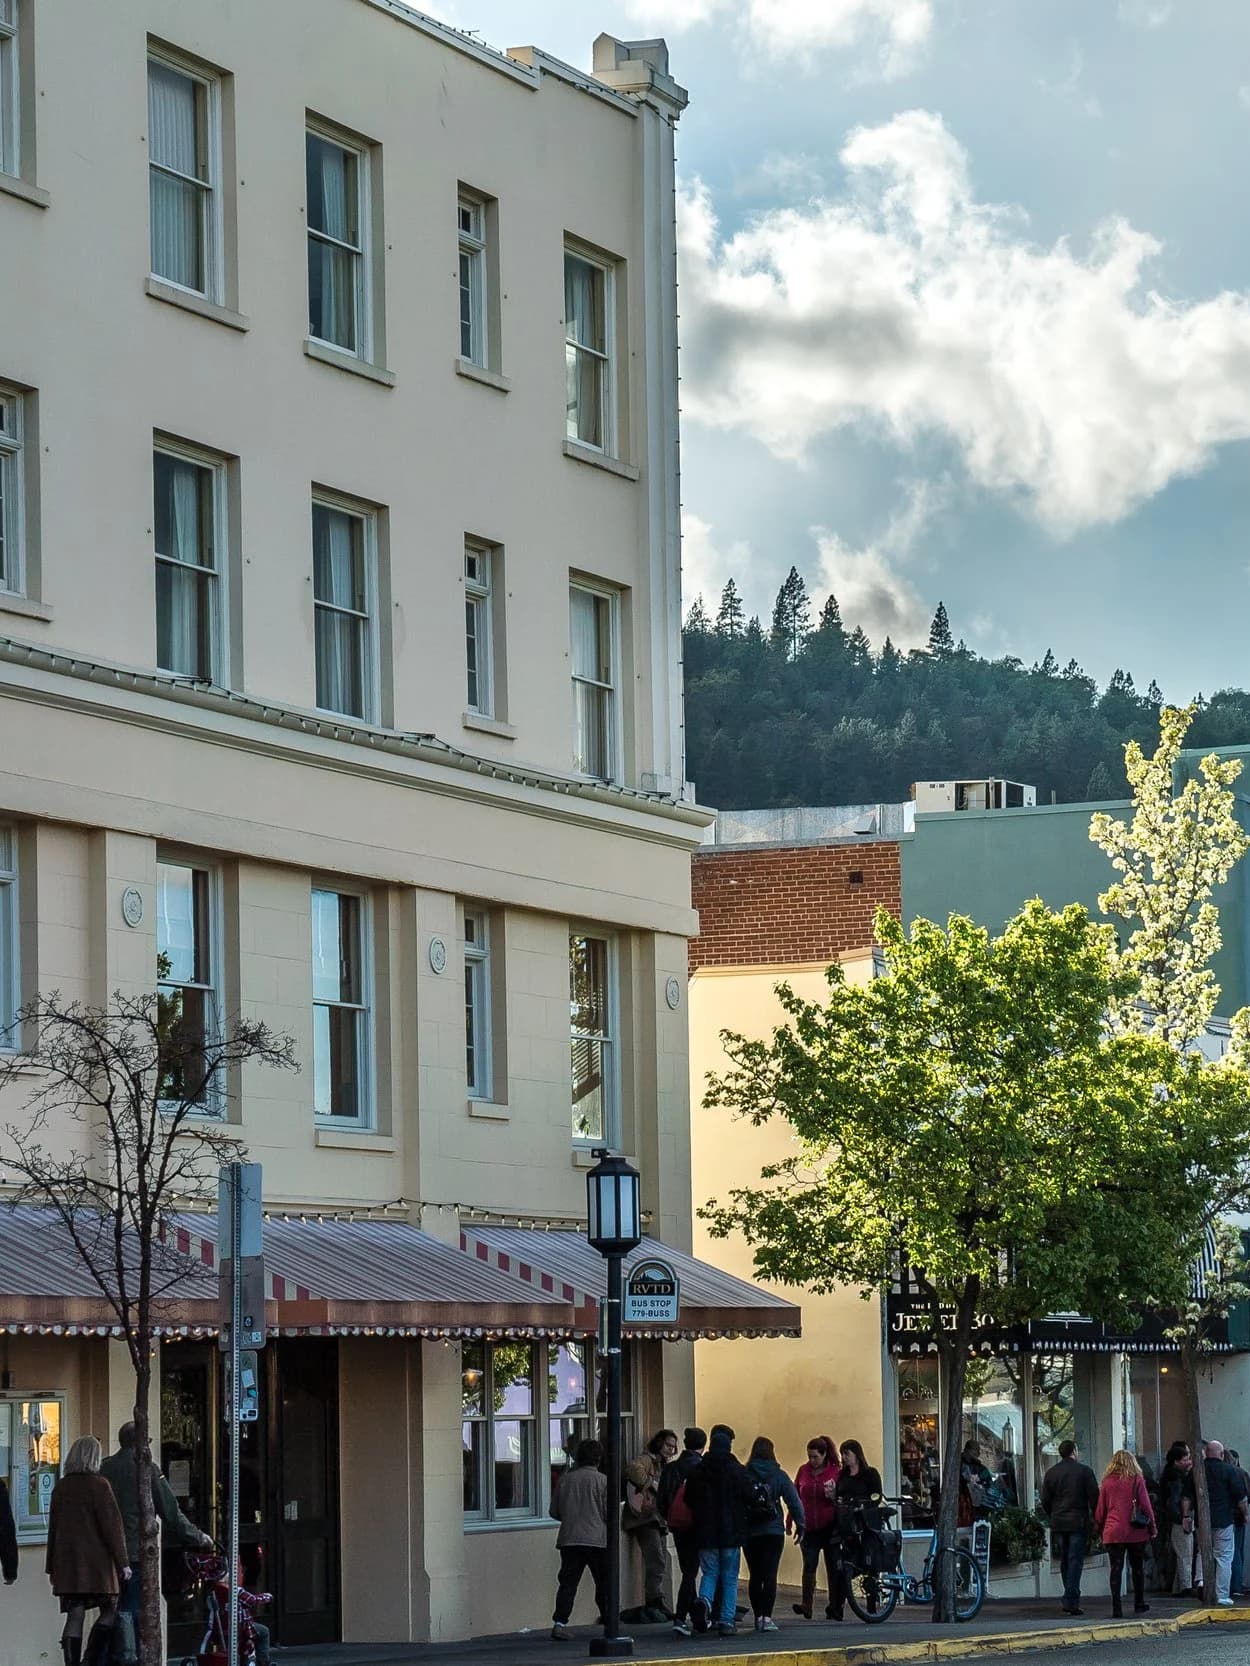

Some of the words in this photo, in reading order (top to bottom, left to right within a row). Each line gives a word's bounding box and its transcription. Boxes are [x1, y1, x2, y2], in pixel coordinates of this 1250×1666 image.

[633, 1283, 671, 1294] RVTD
[632, 1299, 648, 1307] BUS
[650, 1299, 671, 1307] STOP
[632, 1309, 670, 1317] 779-BUSS
